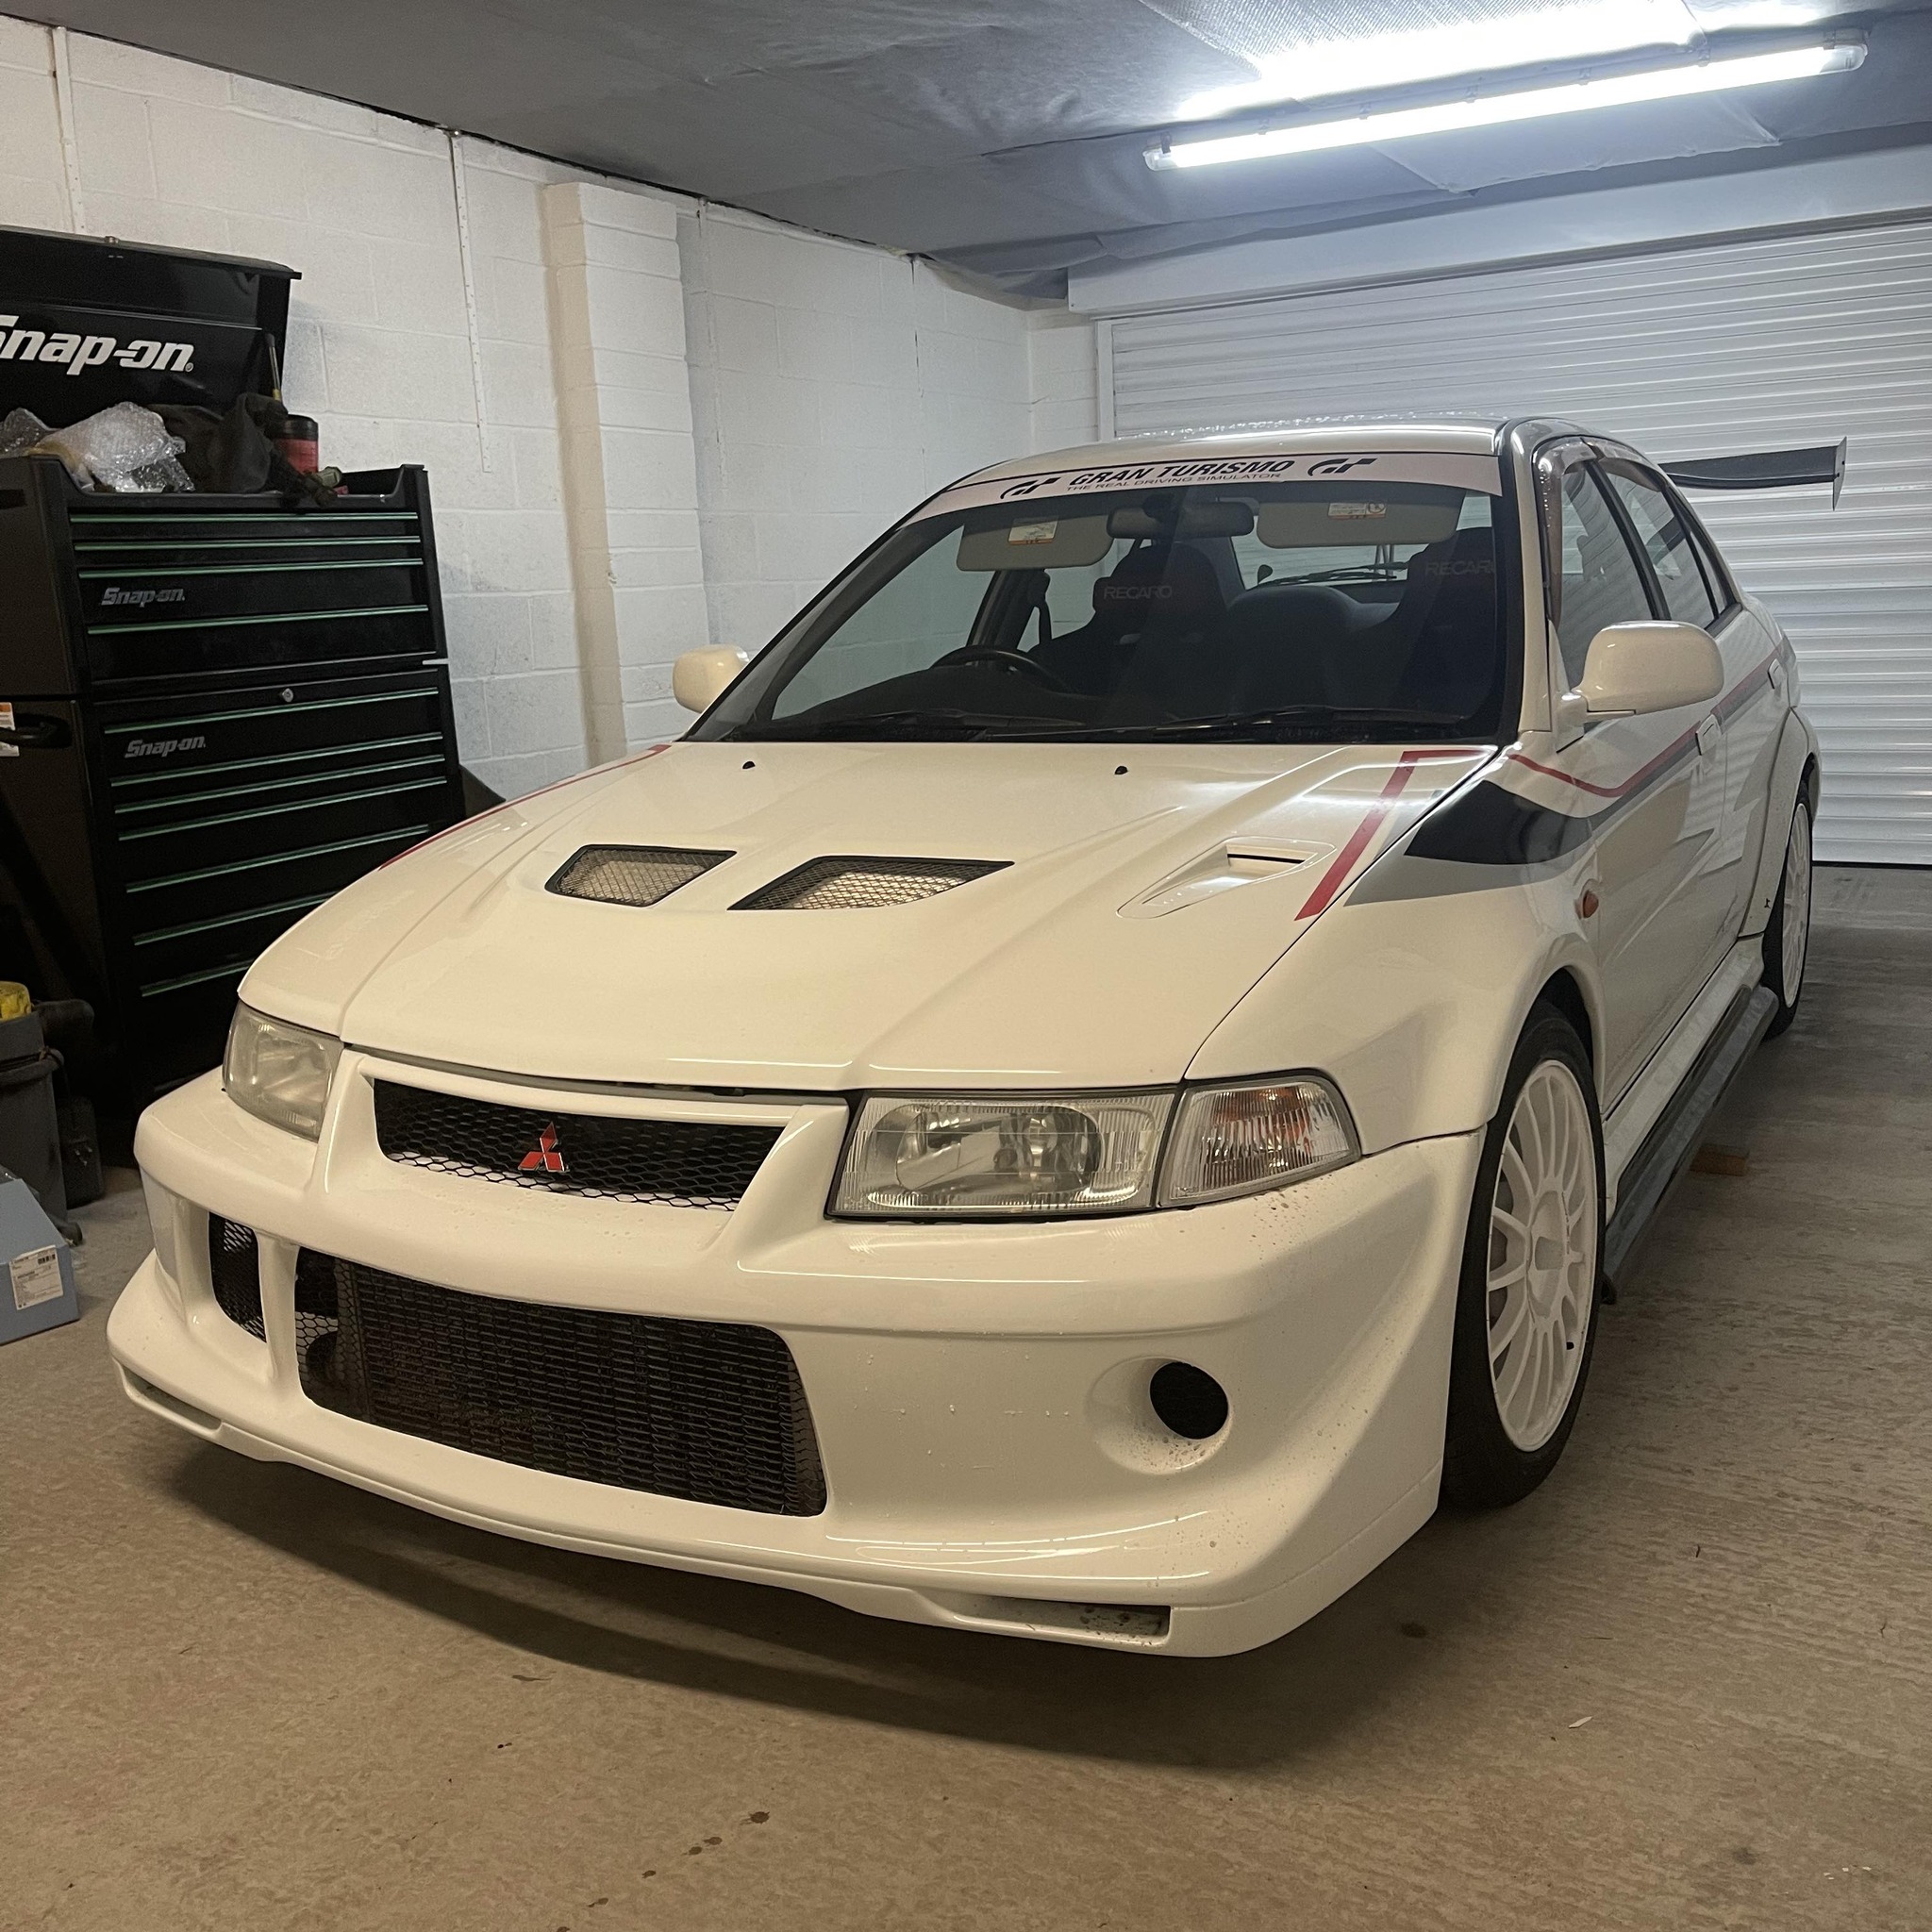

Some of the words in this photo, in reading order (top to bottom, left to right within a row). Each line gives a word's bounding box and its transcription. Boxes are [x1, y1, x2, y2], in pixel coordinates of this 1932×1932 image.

[1069, 467, 1155, 486] GRAN
[1158, 459, 1295, 478] TURISMO
[1095, 481, 1130, 490] REAL
[1134, 476, 1192, 486] DRIVING
[1196, 473, 1281, 482] SIMULATOR
[1425, 559, 1495, 575] RECAR
[101, 587, 185, 608] Snap-on
[1104, 585, 1173, 600] RECARO
[125, 736, 205, 758] Snap-on
